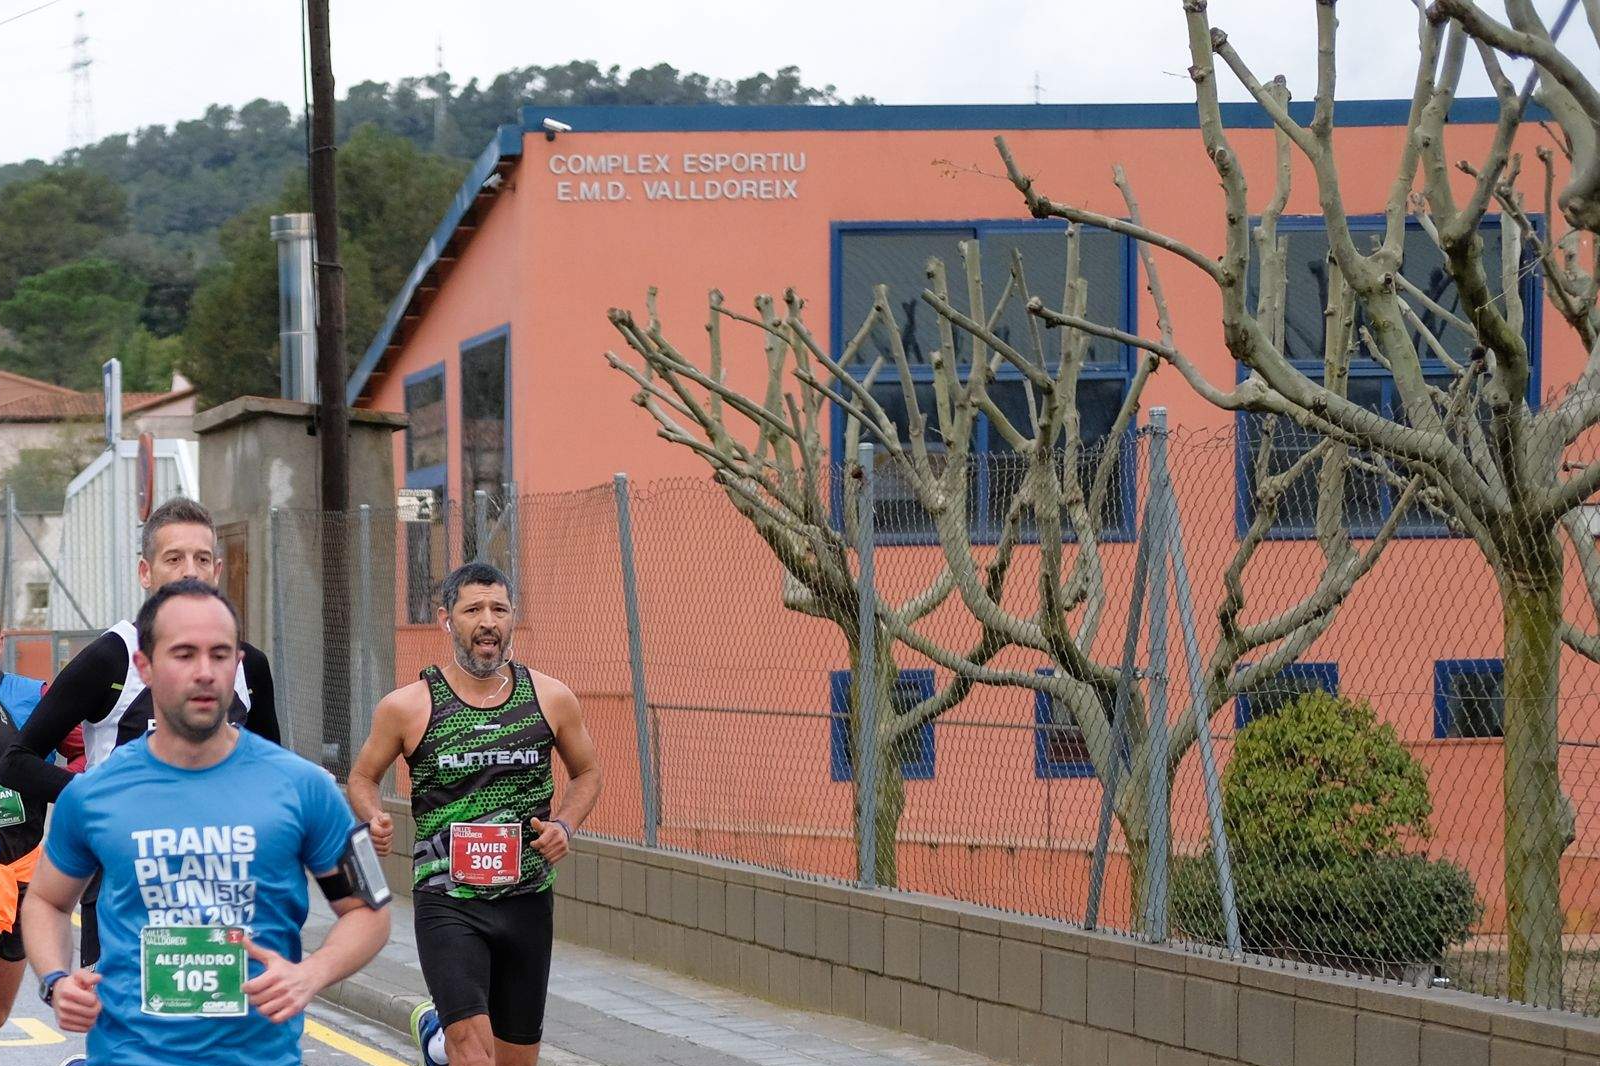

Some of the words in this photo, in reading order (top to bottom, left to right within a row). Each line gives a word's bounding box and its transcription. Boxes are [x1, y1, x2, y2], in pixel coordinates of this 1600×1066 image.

[549, 154, 671, 174] COMPLEX
[683, 152, 807, 174] ESPORTIU
[556, 181, 632, 201] E.M.D.
[643, 179, 799, 200] VALLDOREIX
[438, 750, 539, 768] RUNTEAM
[131, 825, 257, 858] TRANS
[465, 842, 508, 855] JAVIER
[134, 853, 255, 886] PLANT
[470, 854, 503, 870] 306
[140, 880, 214, 909] RUN
[217, 882, 253, 905] 5K
[147, 907, 200, 927] BCN
[205, 903, 256, 927] 2017
[154, 953, 236, 968] ALEJANDRO
[171, 969, 219, 992] 105
